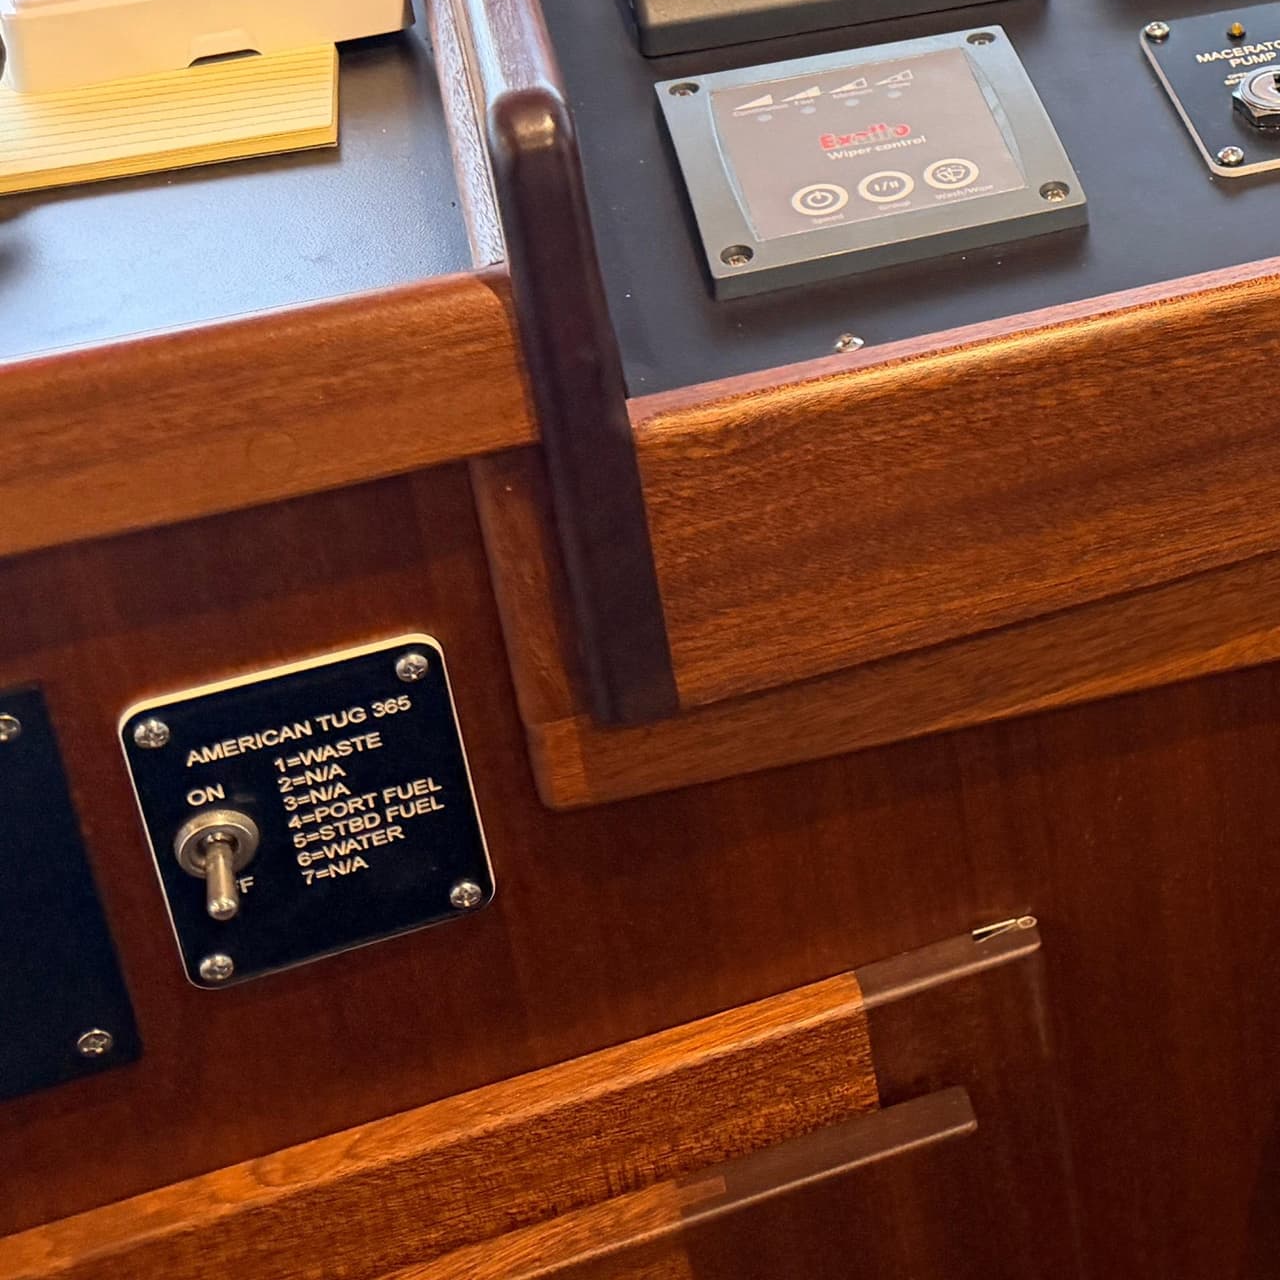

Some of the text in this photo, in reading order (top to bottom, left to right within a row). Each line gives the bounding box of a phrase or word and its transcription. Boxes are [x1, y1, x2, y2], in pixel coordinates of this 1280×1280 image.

[1229, 51, 1277, 68] PUMP
[826, 134, 928, 161] Wiper control
[186, 695, 413, 767] AMERICAN TUG 365
[274, 731, 383, 774] 1=WASTE
[277, 762, 347, 794] 2=N/A
[187, 784, 225, 806] ON
[282, 782, 351, 812] 3=N/A
[287, 776, 443, 830] 4=PORT FUEL
[292, 796, 445, 849] 5=STBD FUEL
[297, 825, 406, 868] 6=WATER
[301, 855, 369, 887] 7=N/A
